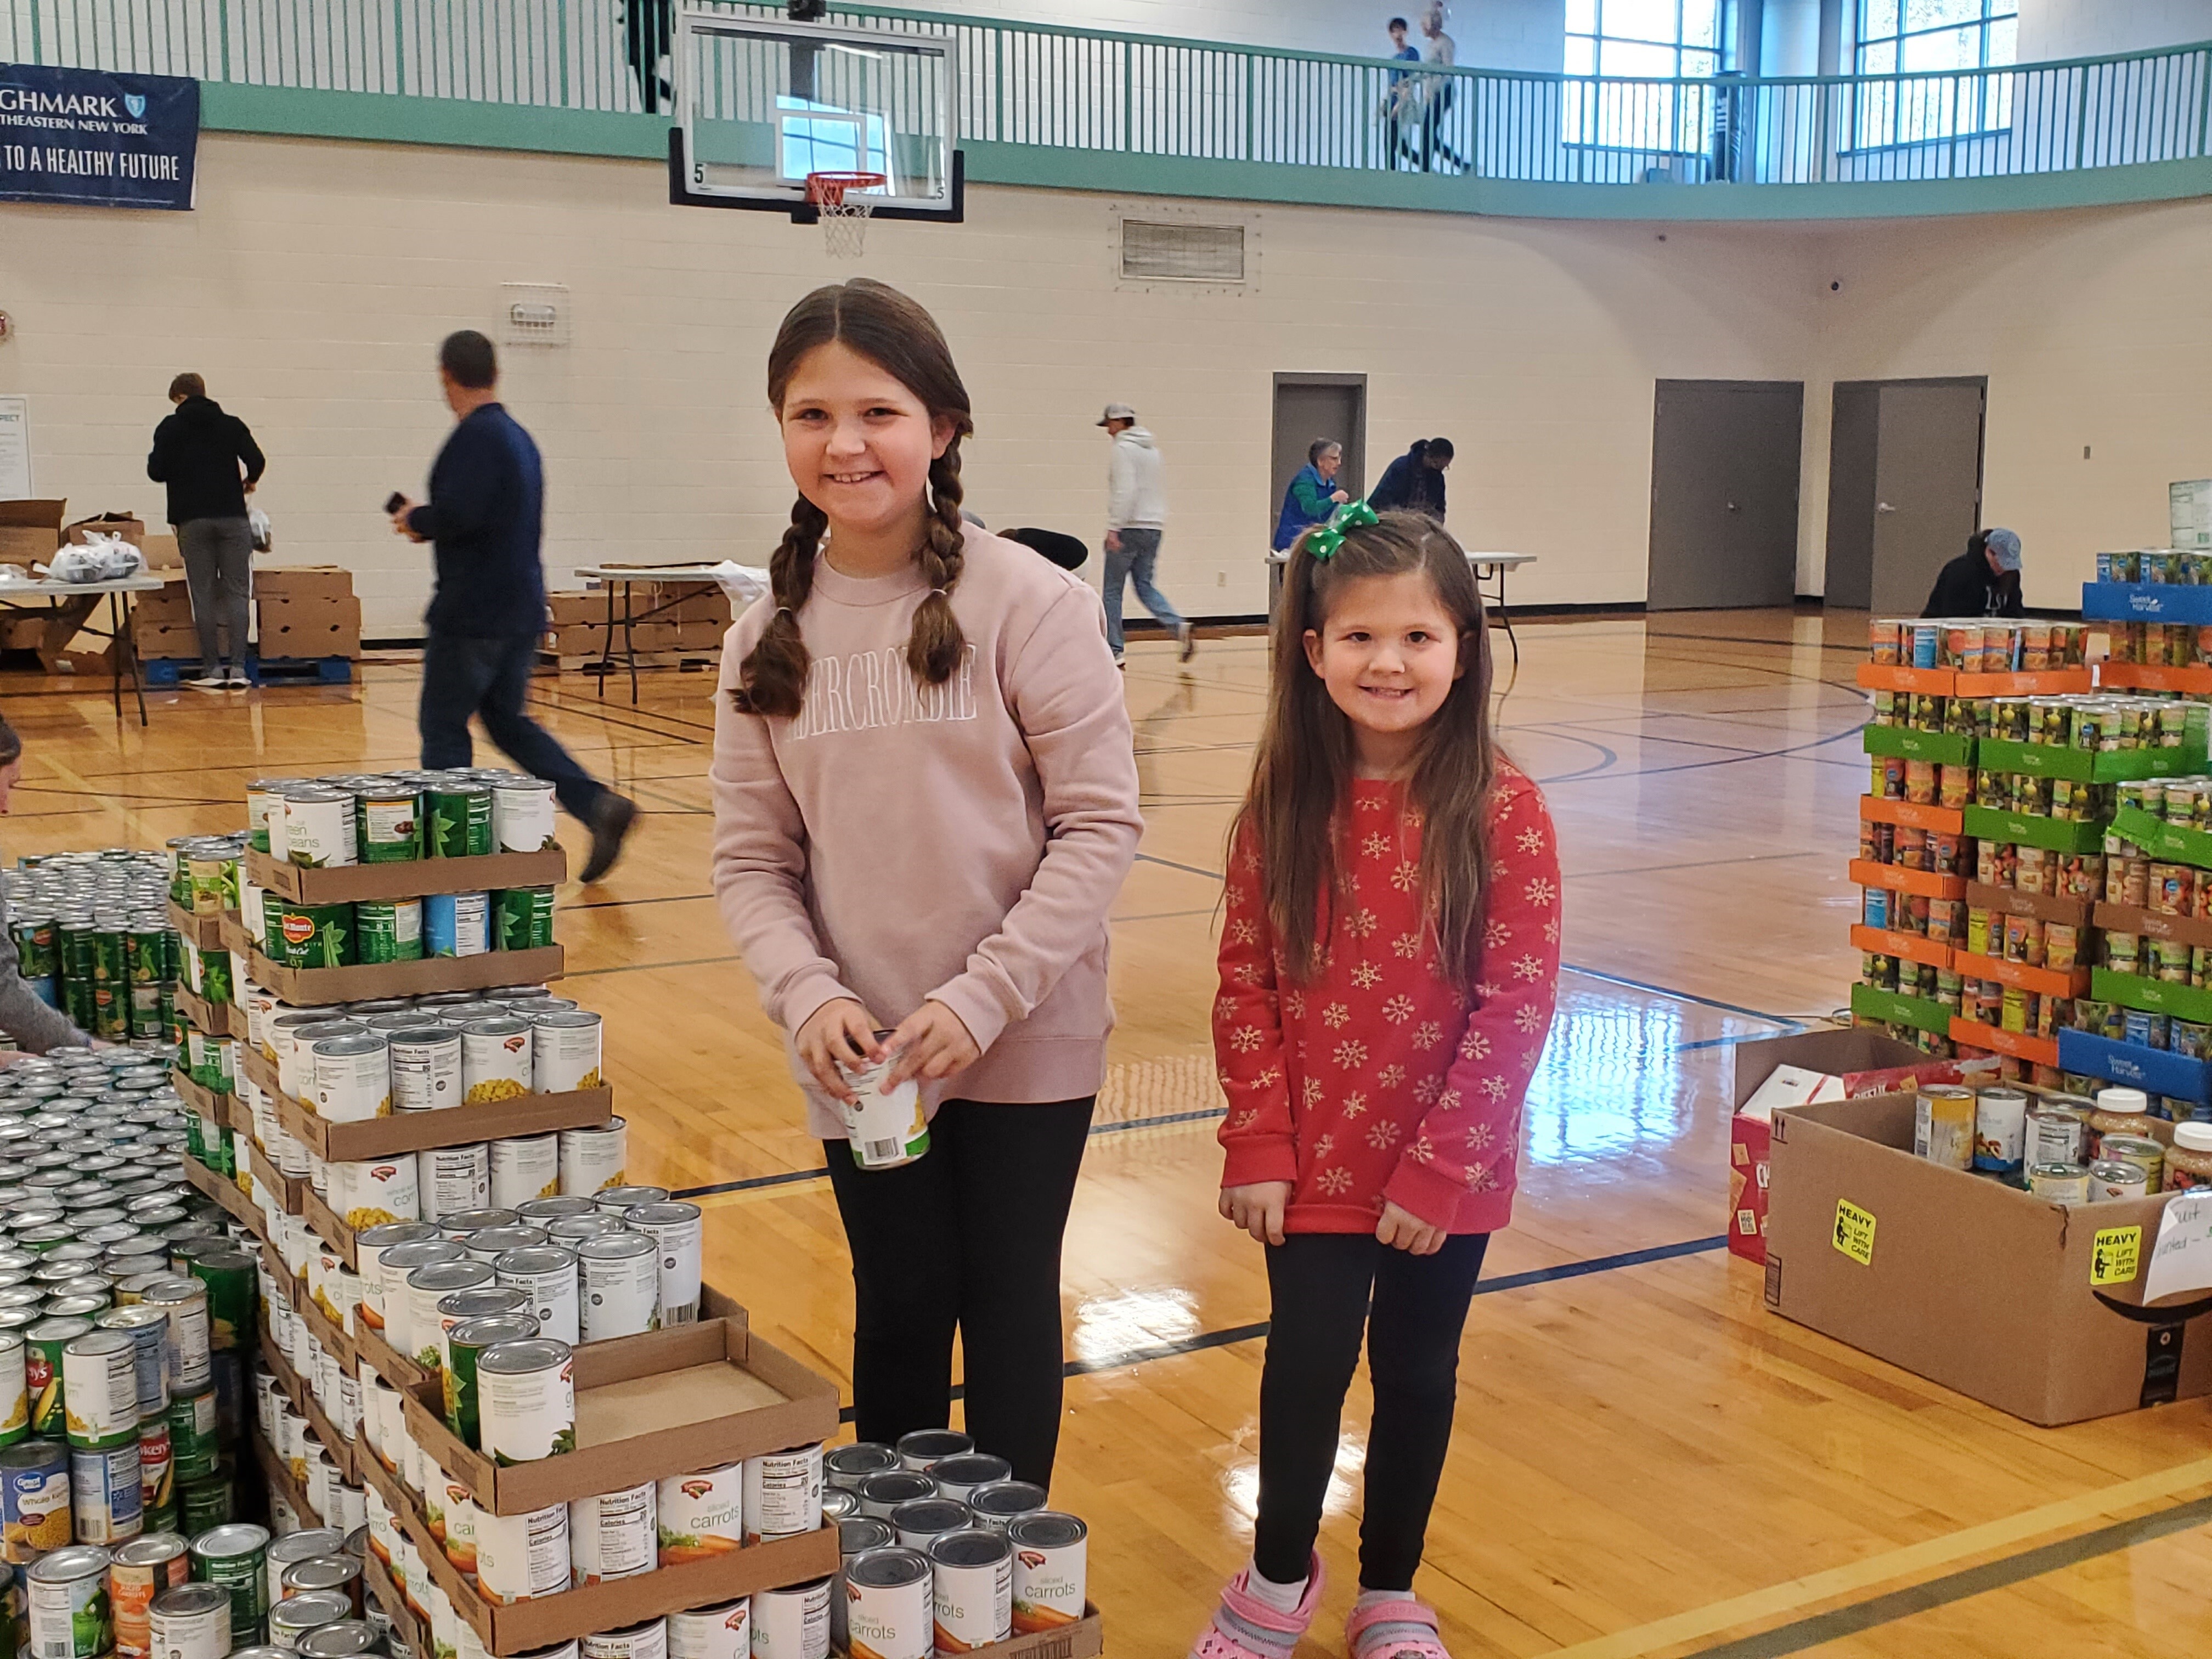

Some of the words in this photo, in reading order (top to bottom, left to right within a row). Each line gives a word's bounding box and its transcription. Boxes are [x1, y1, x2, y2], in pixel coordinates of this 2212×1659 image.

[78, 120, 109, 132] NEW
[113, 122, 148, 135] YORK
[3, 145, 25, 171] TO
[30, 146, 42, 172] A
[46, 148, 114, 176] HEALTHY
[120, 153, 179, 180] FUTURE
[694, 163, 703, 184] 5
[937, 187, 944, 200] 5
[1839, 1204, 1871, 1228] HEAVY
[1853, 1228, 1868, 1240] LIFT
[2096, 1232, 2137, 1247] HEAVY
[1853, 1236, 1870, 1249] WITH
[1851, 1245, 1870, 1260] CARE
[2116, 1248, 2134, 1258] LIFT
[2115, 1257, 2135, 1267] WITH
[2114, 1266, 2136, 1277] CARE
[793, 1458, 808, 1466] Facts
[600, 1496, 630, 1506] Nutrition
[631, 1491, 646, 1501] Facts
[691, 1506, 739, 1529] carrots
[1025, 1582, 1076, 1599] carrots
[850, 1620, 896, 1640] carrots
